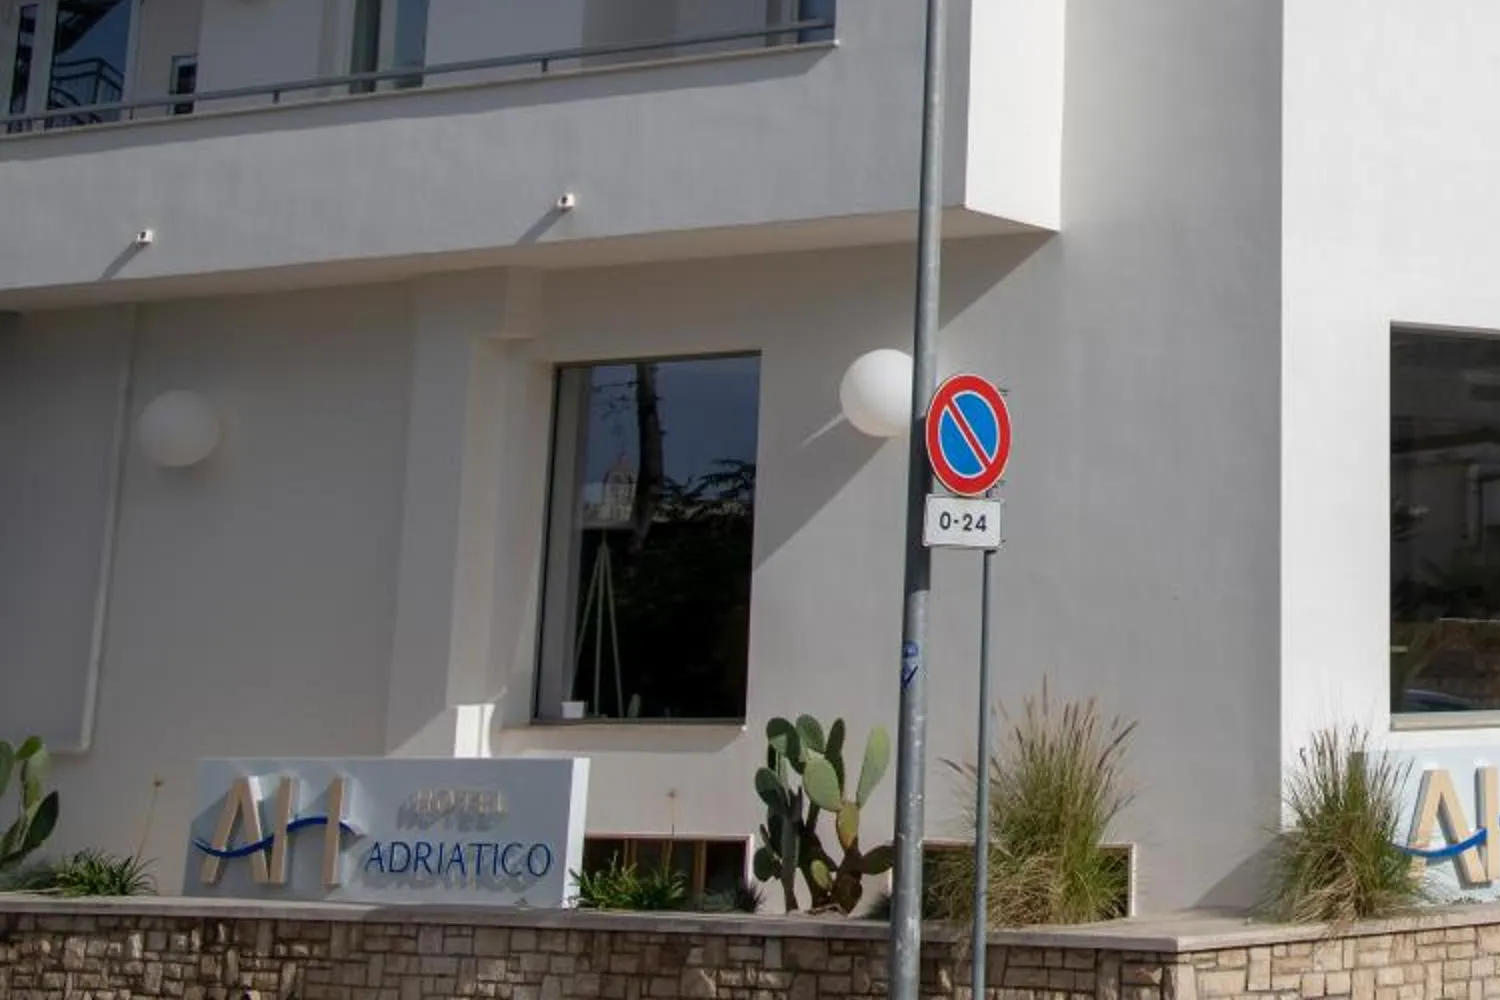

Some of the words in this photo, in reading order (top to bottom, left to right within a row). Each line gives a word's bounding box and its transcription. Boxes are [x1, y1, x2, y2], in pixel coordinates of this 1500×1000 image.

[940, 511, 987, 532] 0-24
[414, 788, 507, 815] HOTEL
[365, 841, 552, 878] ADRIATICO
